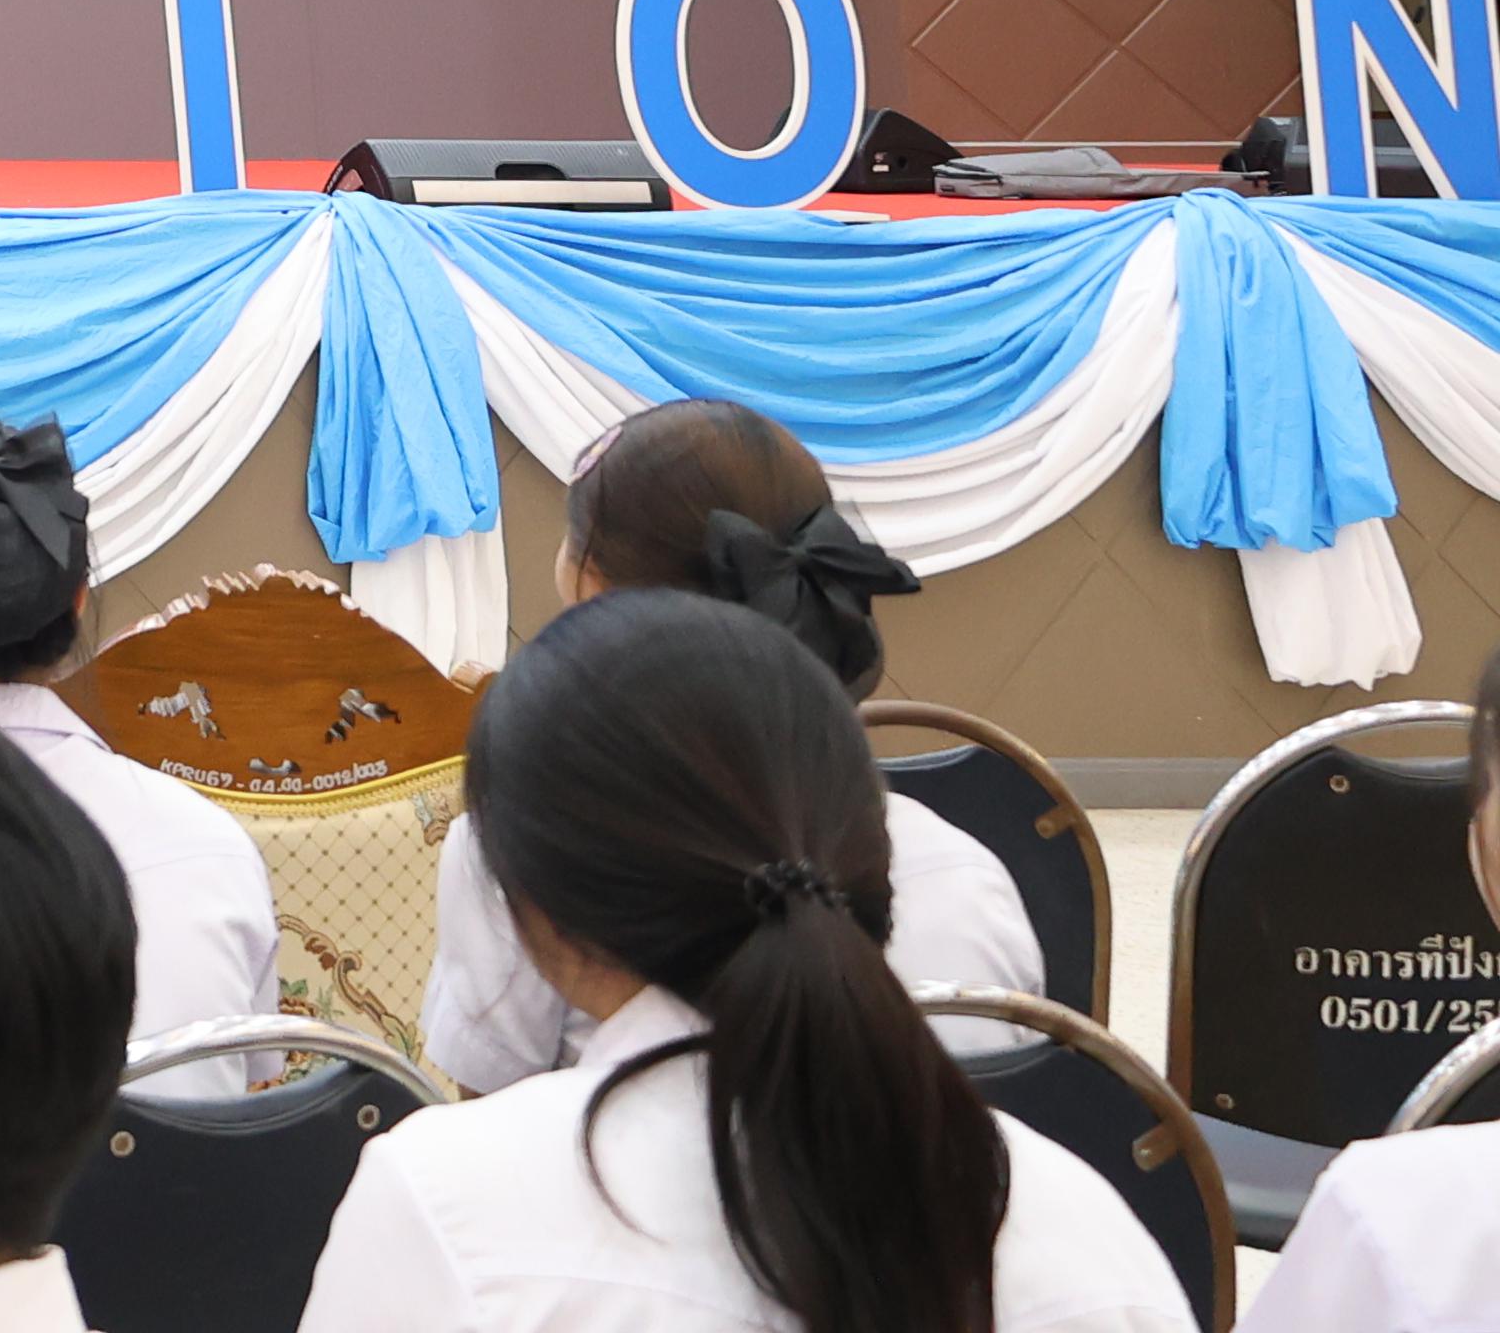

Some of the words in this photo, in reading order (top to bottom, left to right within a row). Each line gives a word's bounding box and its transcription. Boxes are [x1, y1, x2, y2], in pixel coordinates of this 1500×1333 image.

[1295, 933, 1500, 981] อาคารทีปัง
[1320, 995, 1500, 1035] 0501/25
